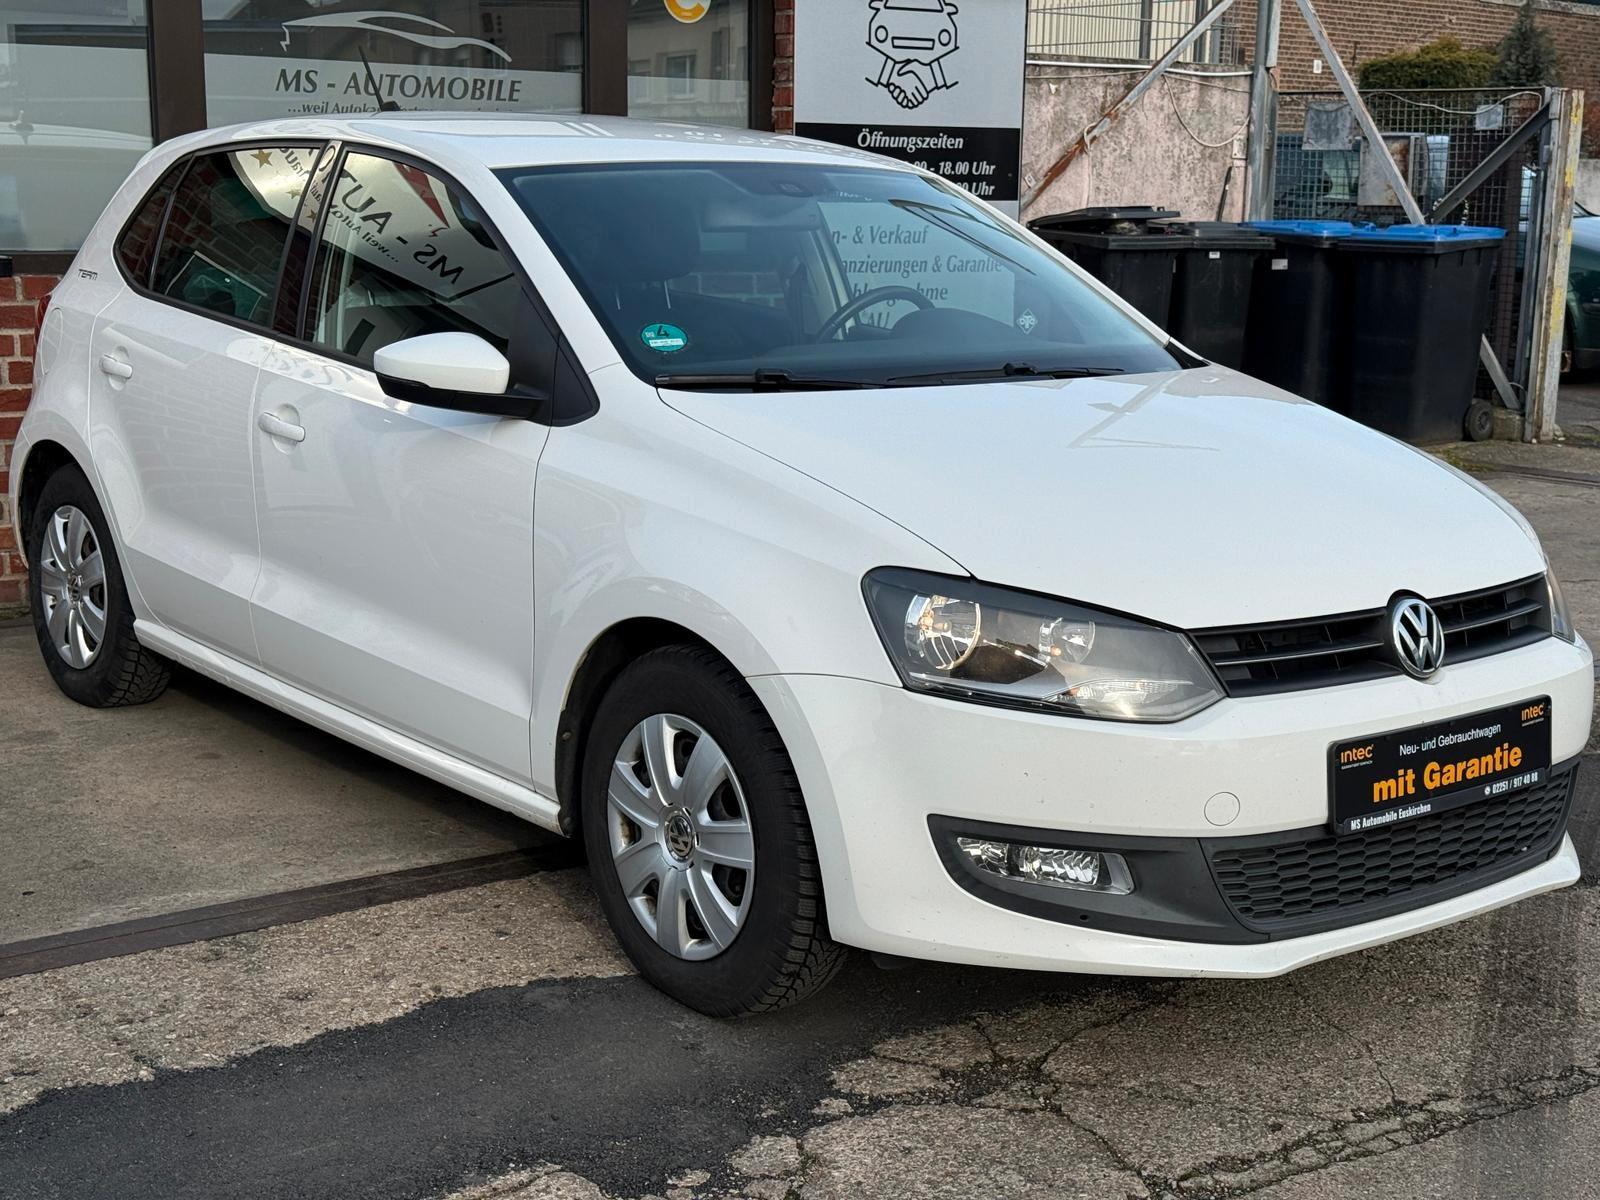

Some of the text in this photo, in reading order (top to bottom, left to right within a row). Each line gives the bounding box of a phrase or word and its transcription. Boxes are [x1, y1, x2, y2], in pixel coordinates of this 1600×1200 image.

[275, 68, 318, 93] MS
[344, 71, 523, 103] AUTOMOBILE
[857, 128, 964, 153] Öffnungszeiten
[938, 161, 969, 175] 18.00
[972, 160, 995, 176] Uhr
[972, 181, 995, 196] Uhr
[852, 225, 864, 244] &
[869, 224, 930, 244] Verkauf
[932, 255, 943, 273] &
[946, 254, 1002, 273] Garantie
[1399, 723, 1502, 757] Neu- und Gebrauchtwagen
[1373, 742, 1522, 803] mit Garantie
[1492, 780, 1508, 794] 02251
[1513, 776, 1523, 788] 917
[1350, 803, 1432, 831] MS Automobile Euskirchen
